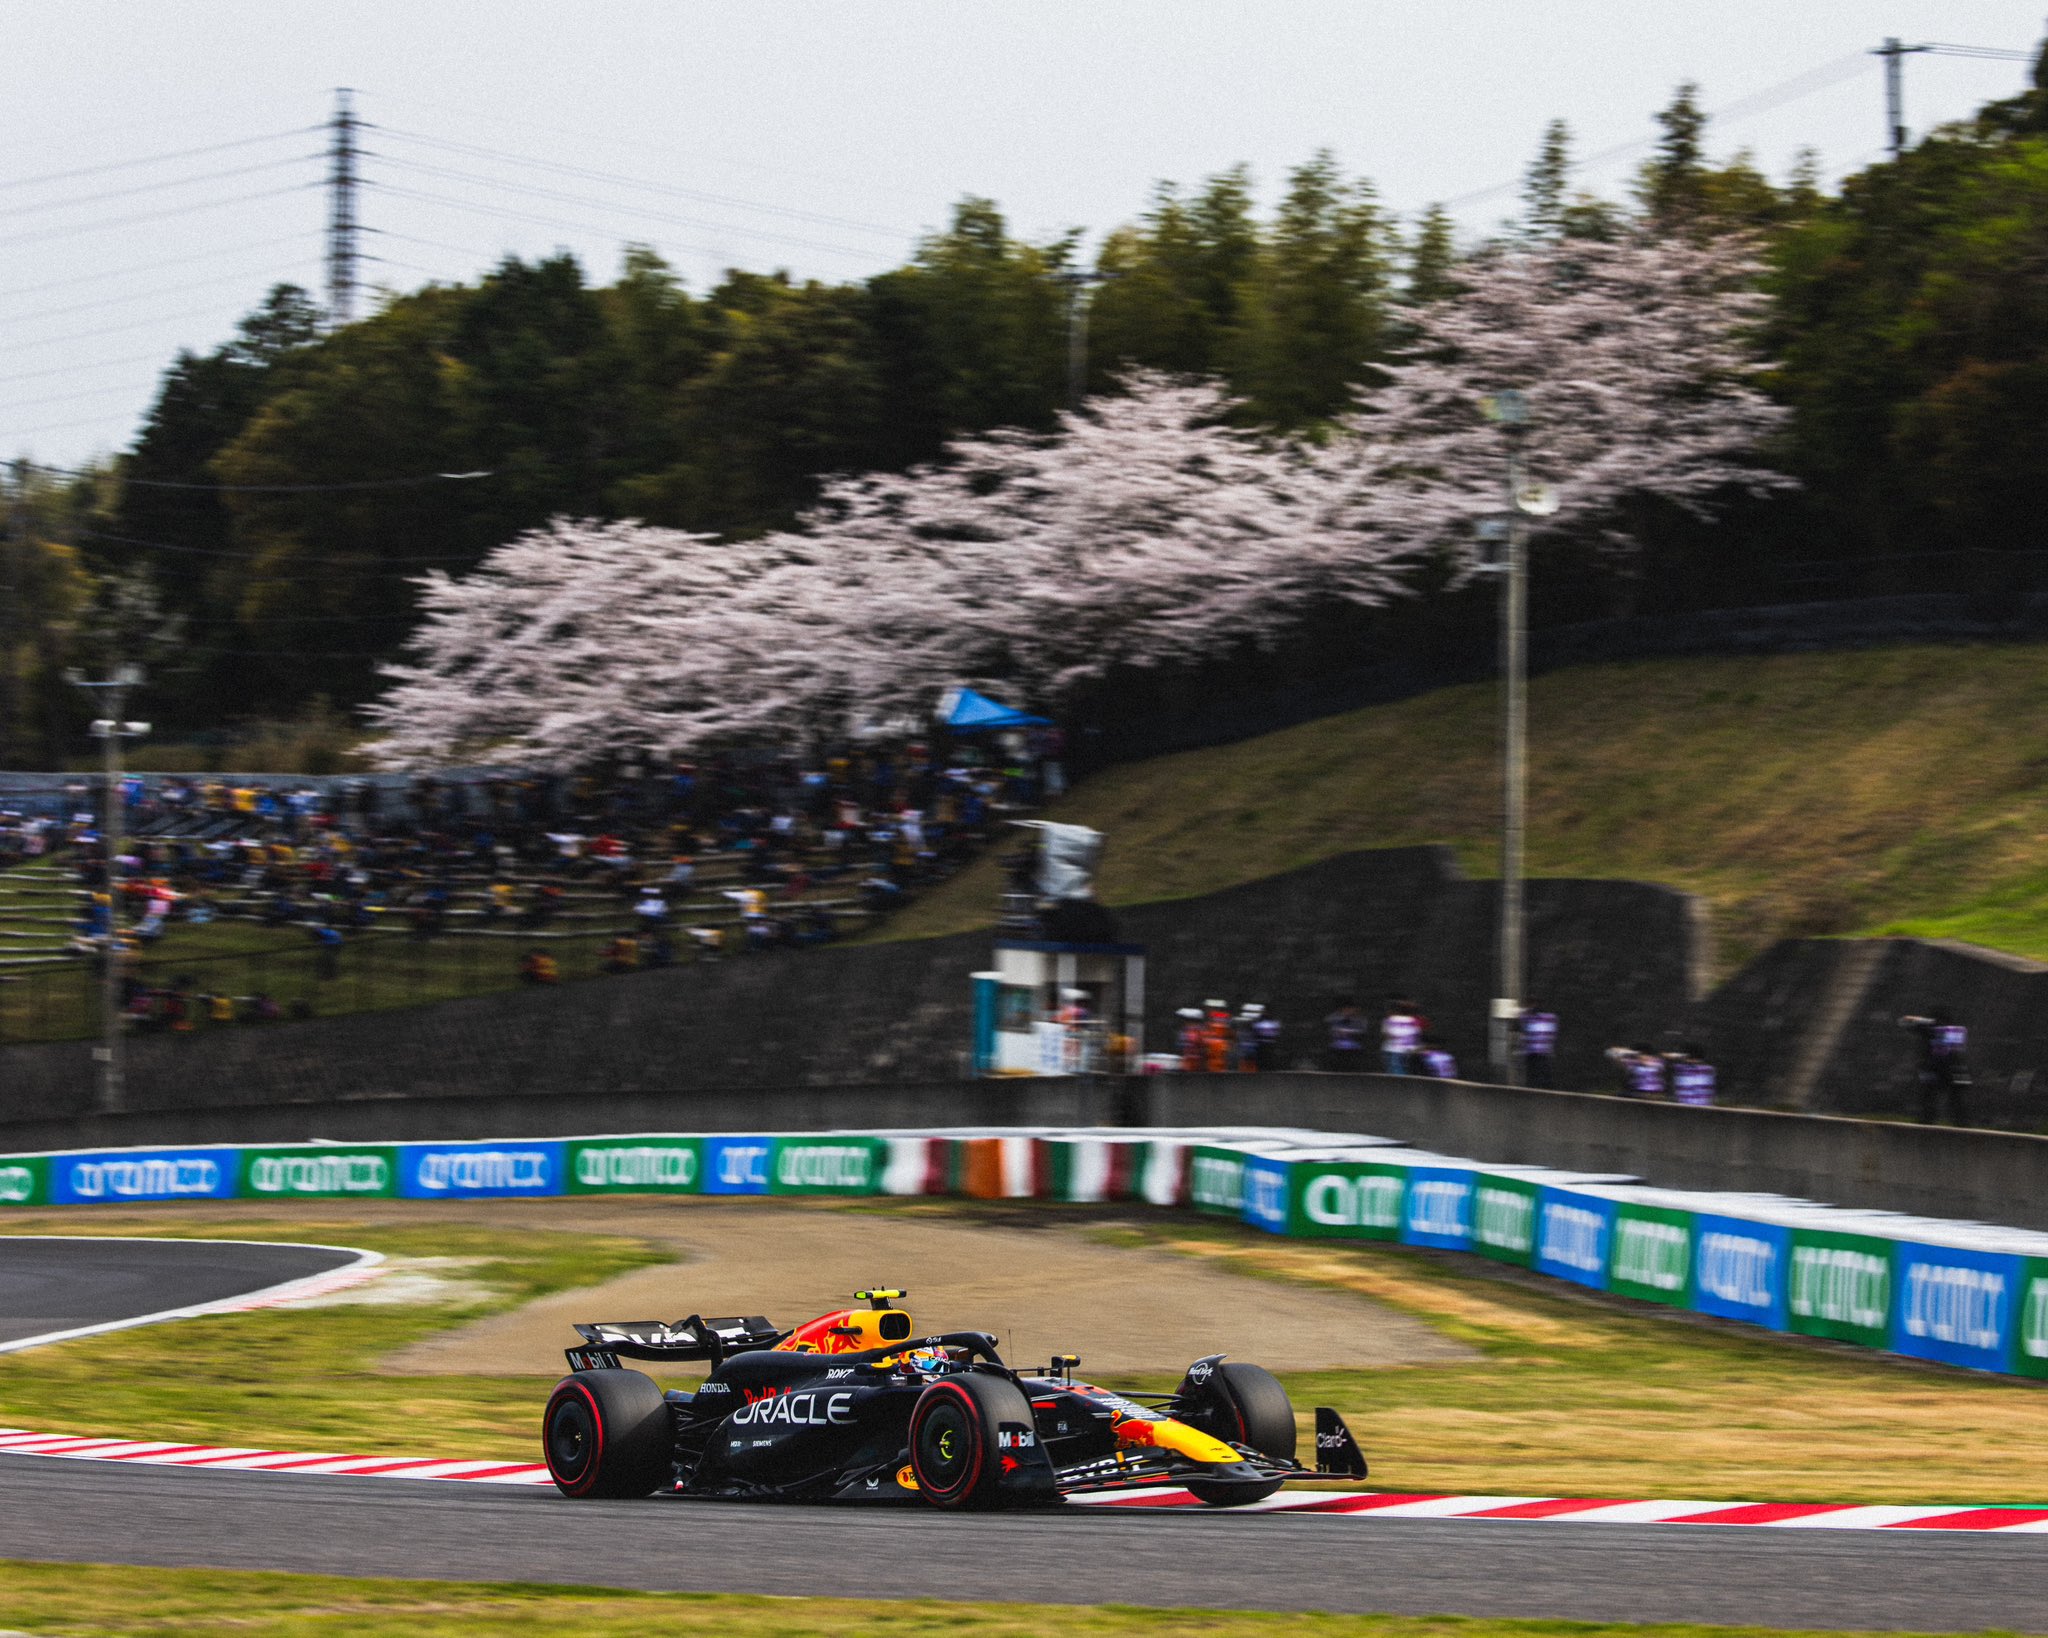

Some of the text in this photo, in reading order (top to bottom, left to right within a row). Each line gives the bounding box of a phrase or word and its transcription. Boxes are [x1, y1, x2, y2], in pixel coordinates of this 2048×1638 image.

[569, 1351, 617, 1370] Mobil 1
[700, 1383, 731, 1393] HONDA
[733, 1393, 858, 1425] ORACLE
[998, 1431, 1035, 1447] Mobil
[1317, 1432, 1343, 1448] Claro
